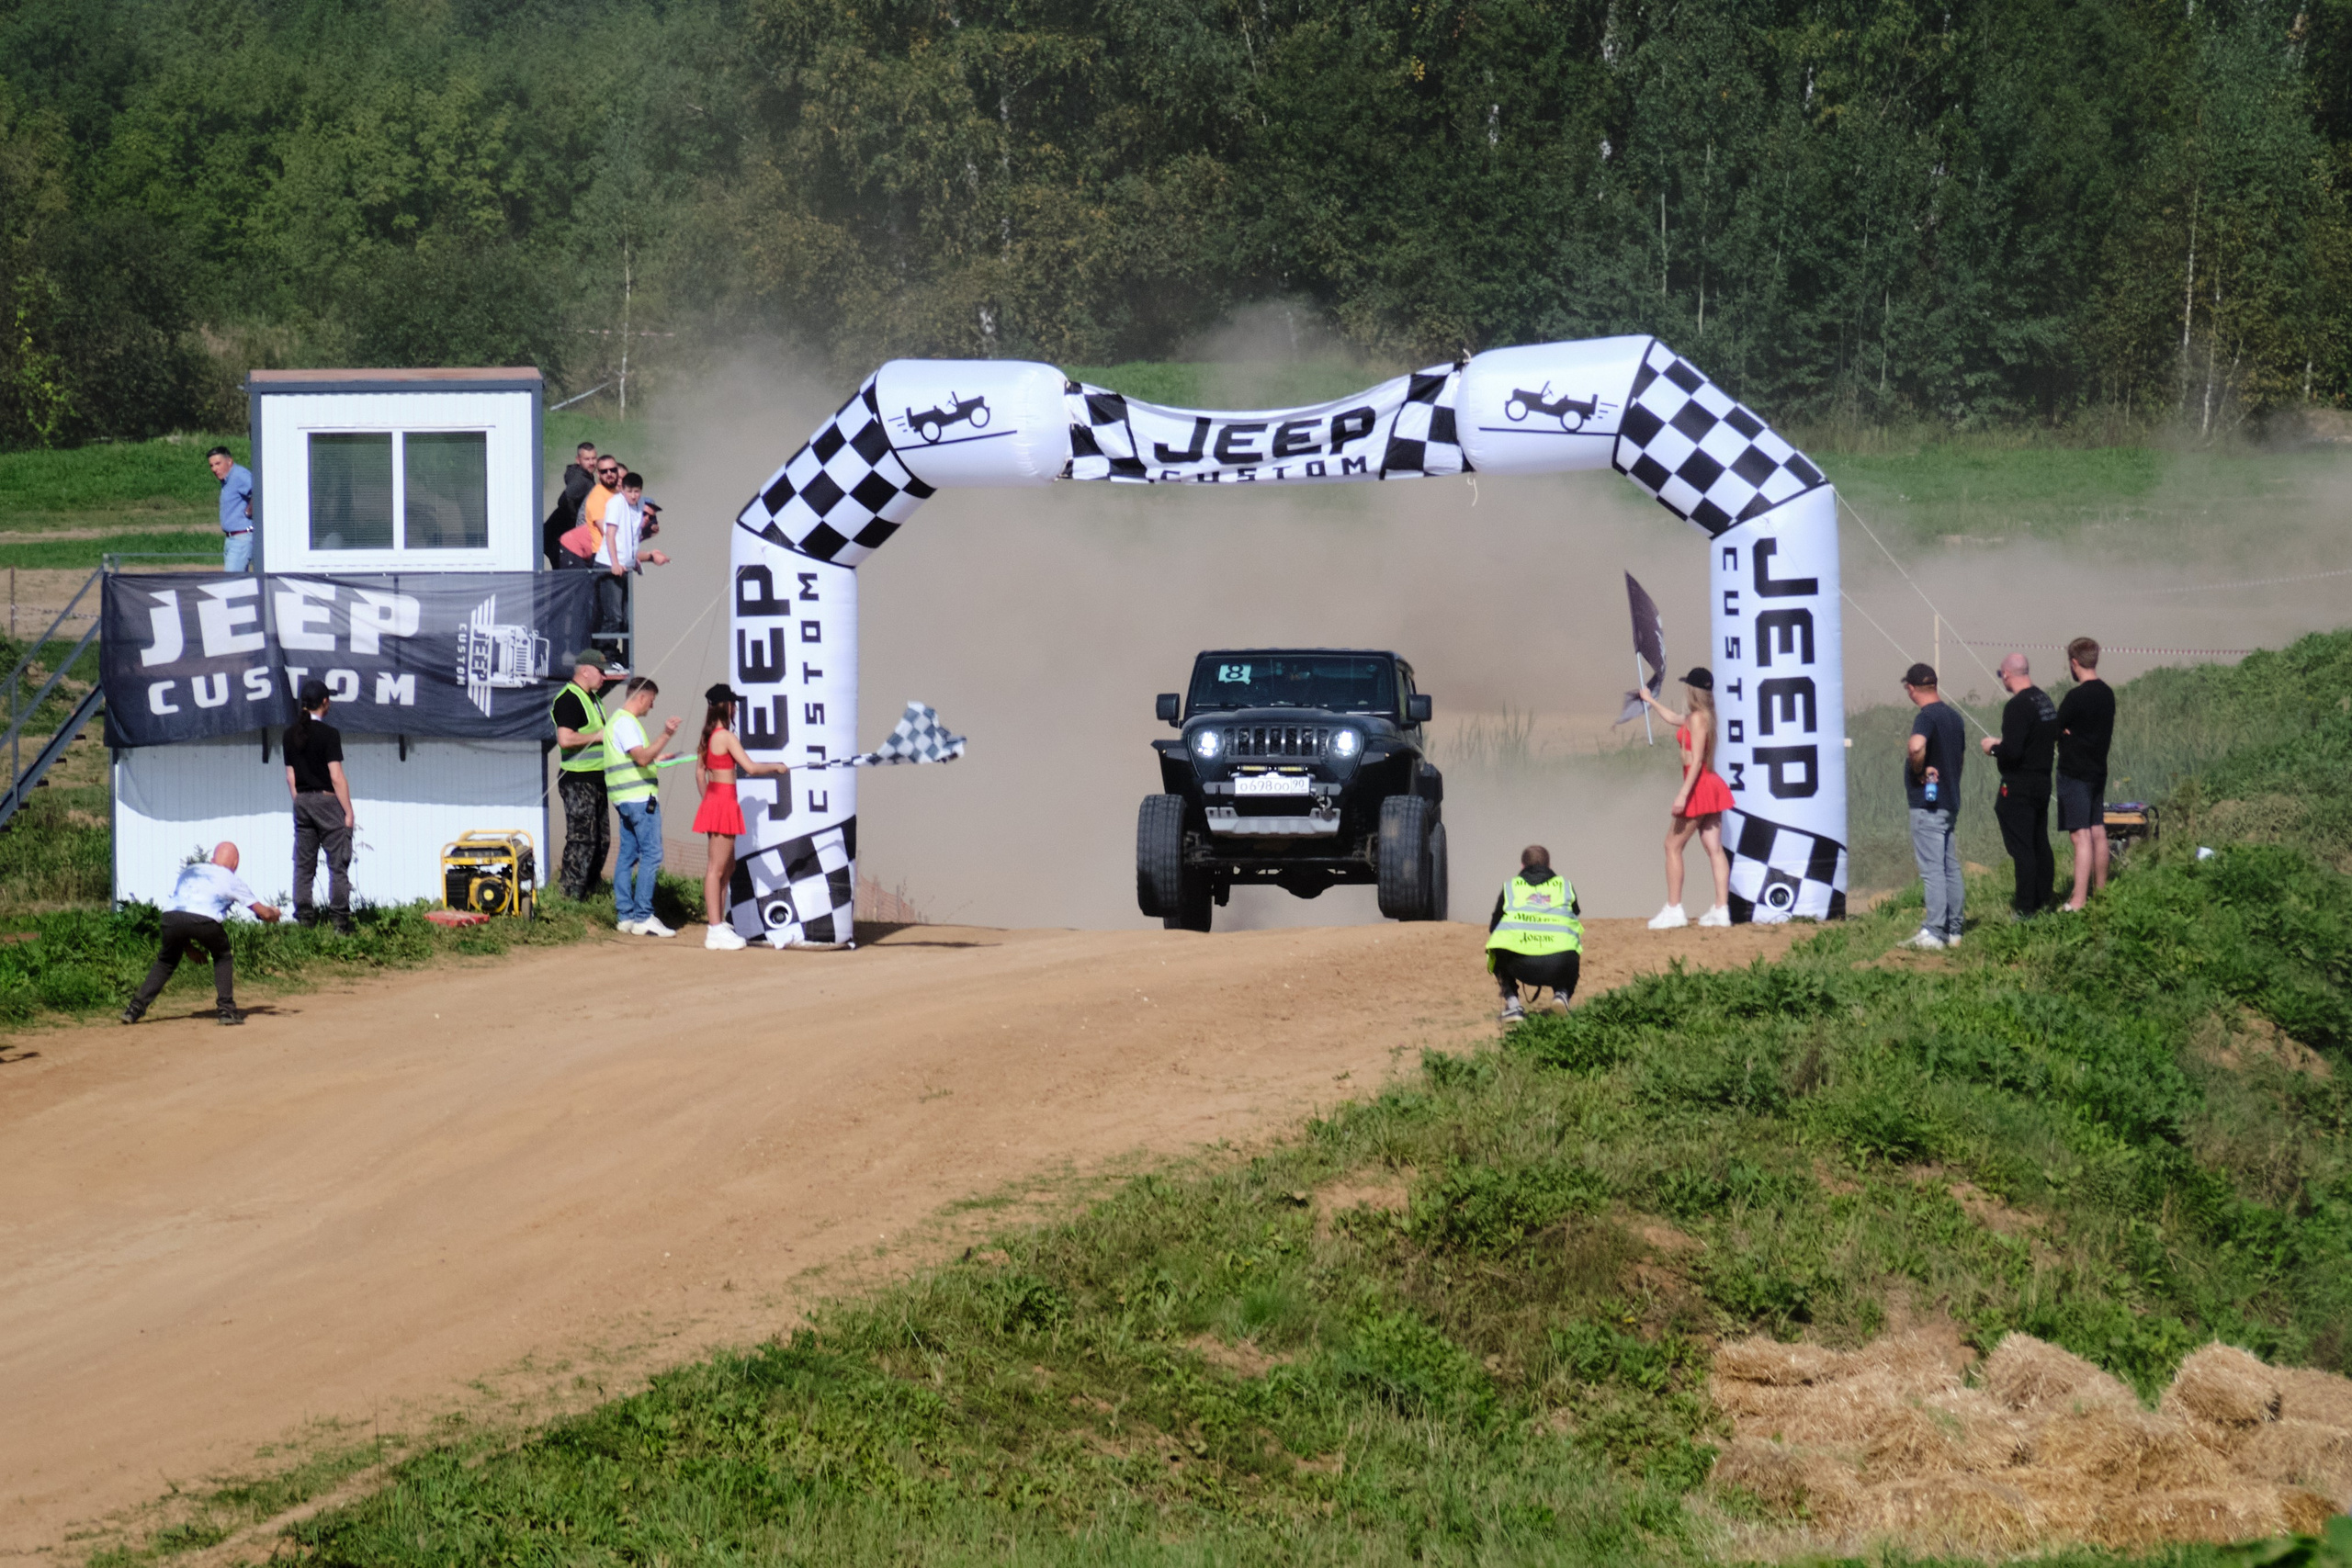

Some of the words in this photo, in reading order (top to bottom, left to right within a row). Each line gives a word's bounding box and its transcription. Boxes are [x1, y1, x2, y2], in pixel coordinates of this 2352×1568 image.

[1153, 406, 1376, 465] JEEP
[1160, 456, 1367, 483] CUSTOM
[140, 576, 420, 667] JEEP
[457, 623, 467, 685] CUSTOM
[147, 665, 415, 716] CUSTOM
[735, 564, 792, 820] JEEP
[797, 572, 828, 813] CUSTOM
[1226, 663, 1244, 680] 8
[1722, 547, 1746, 791] CUSTOM
[1751, 537, 1819, 799] JEEP
